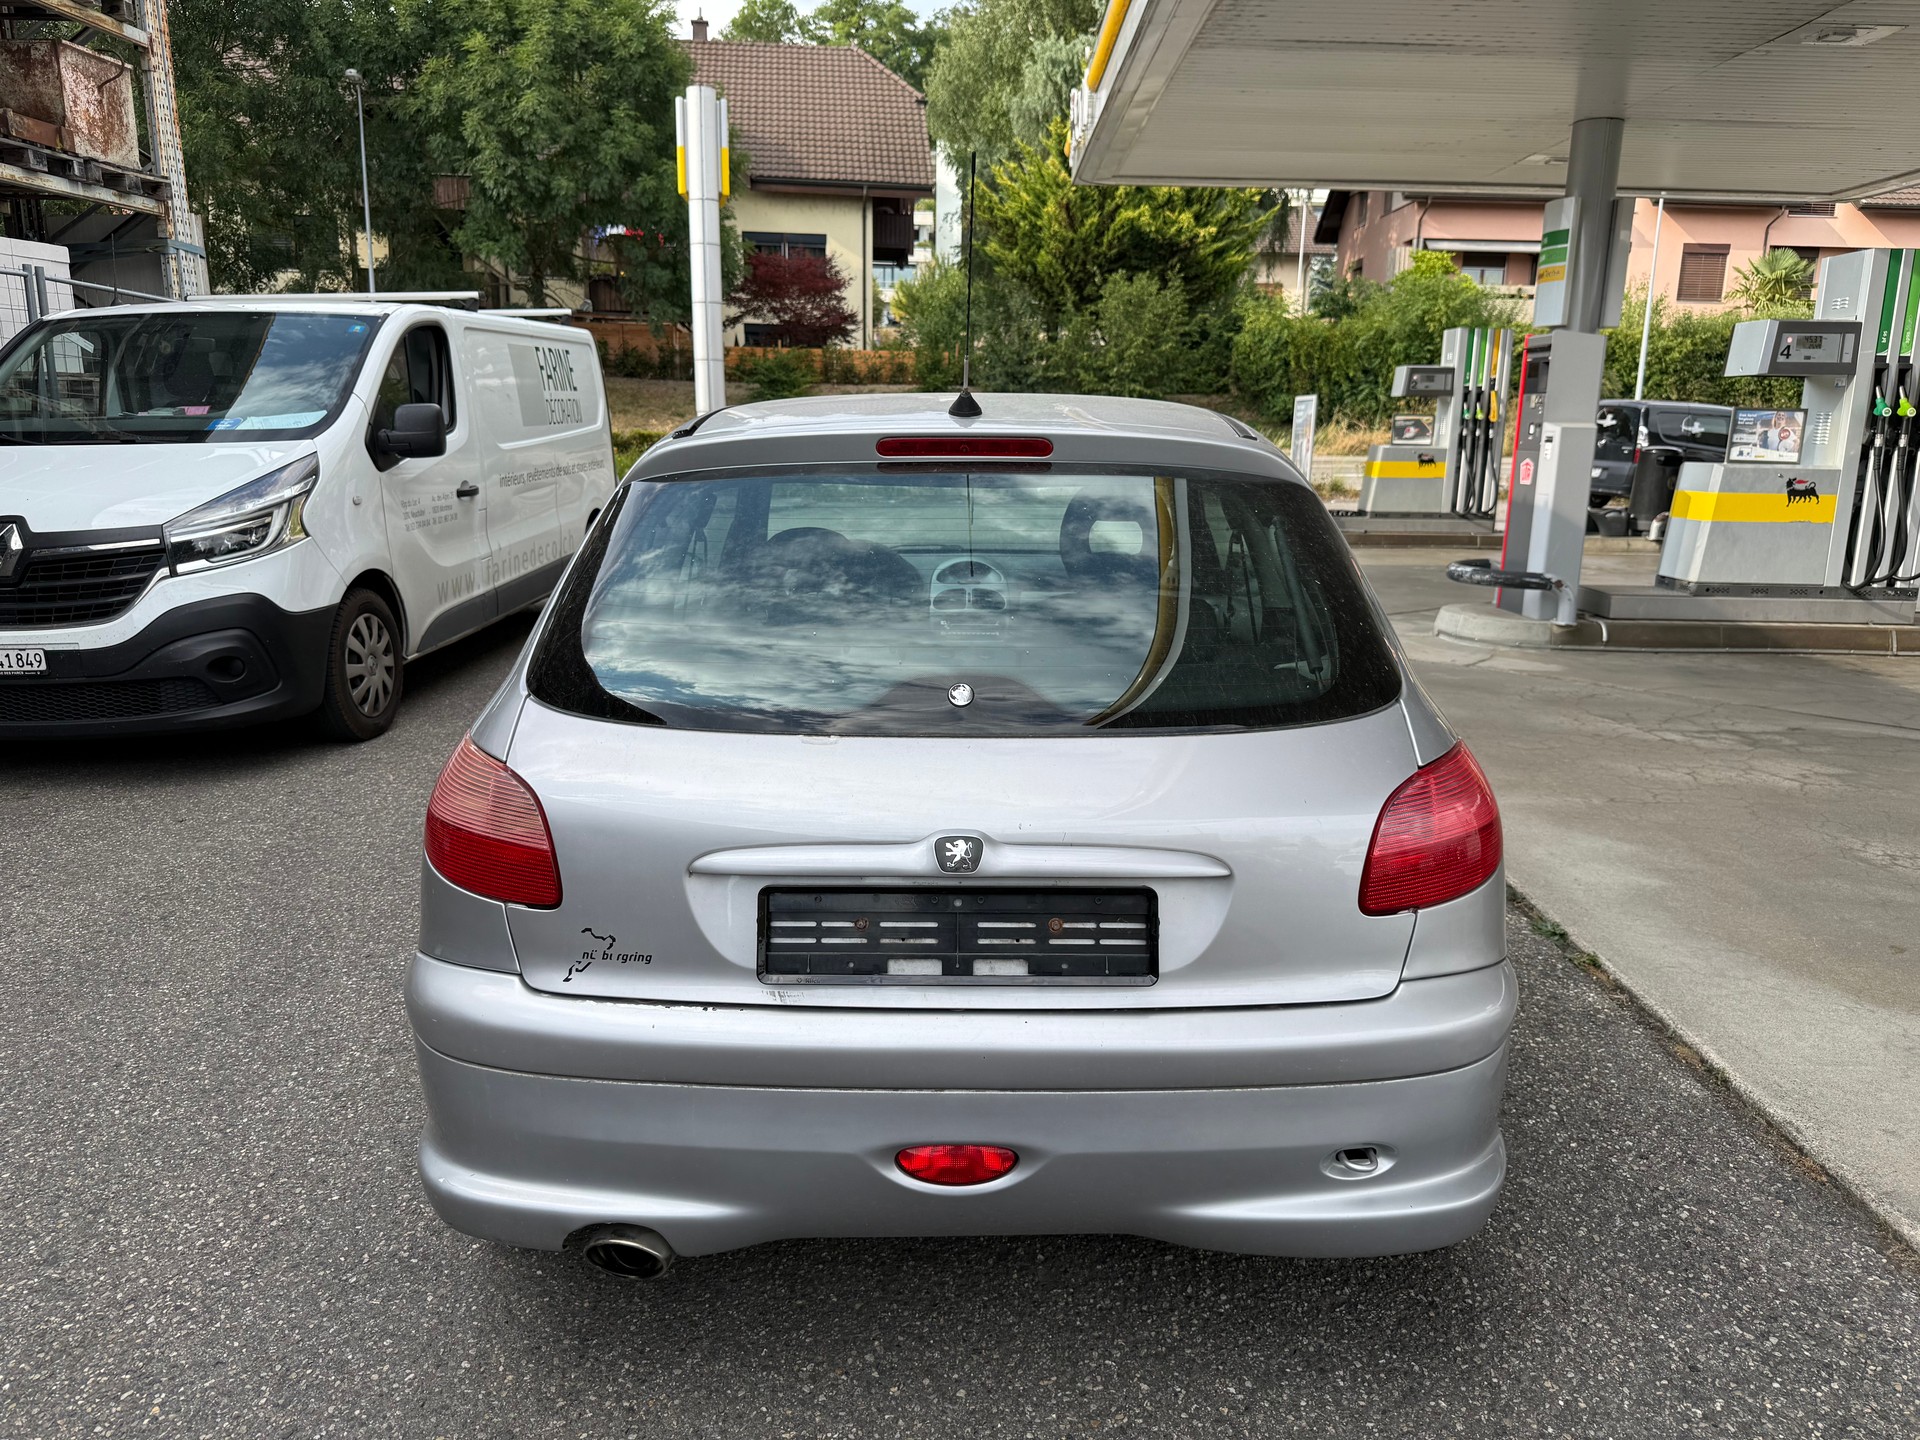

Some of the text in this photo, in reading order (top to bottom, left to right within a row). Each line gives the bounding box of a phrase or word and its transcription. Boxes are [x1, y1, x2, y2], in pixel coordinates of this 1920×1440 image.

[1780, 344, 1792, 360] 4
[535, 346, 578, 391] FARINE
[1411, 380, 1417, 389] 2
